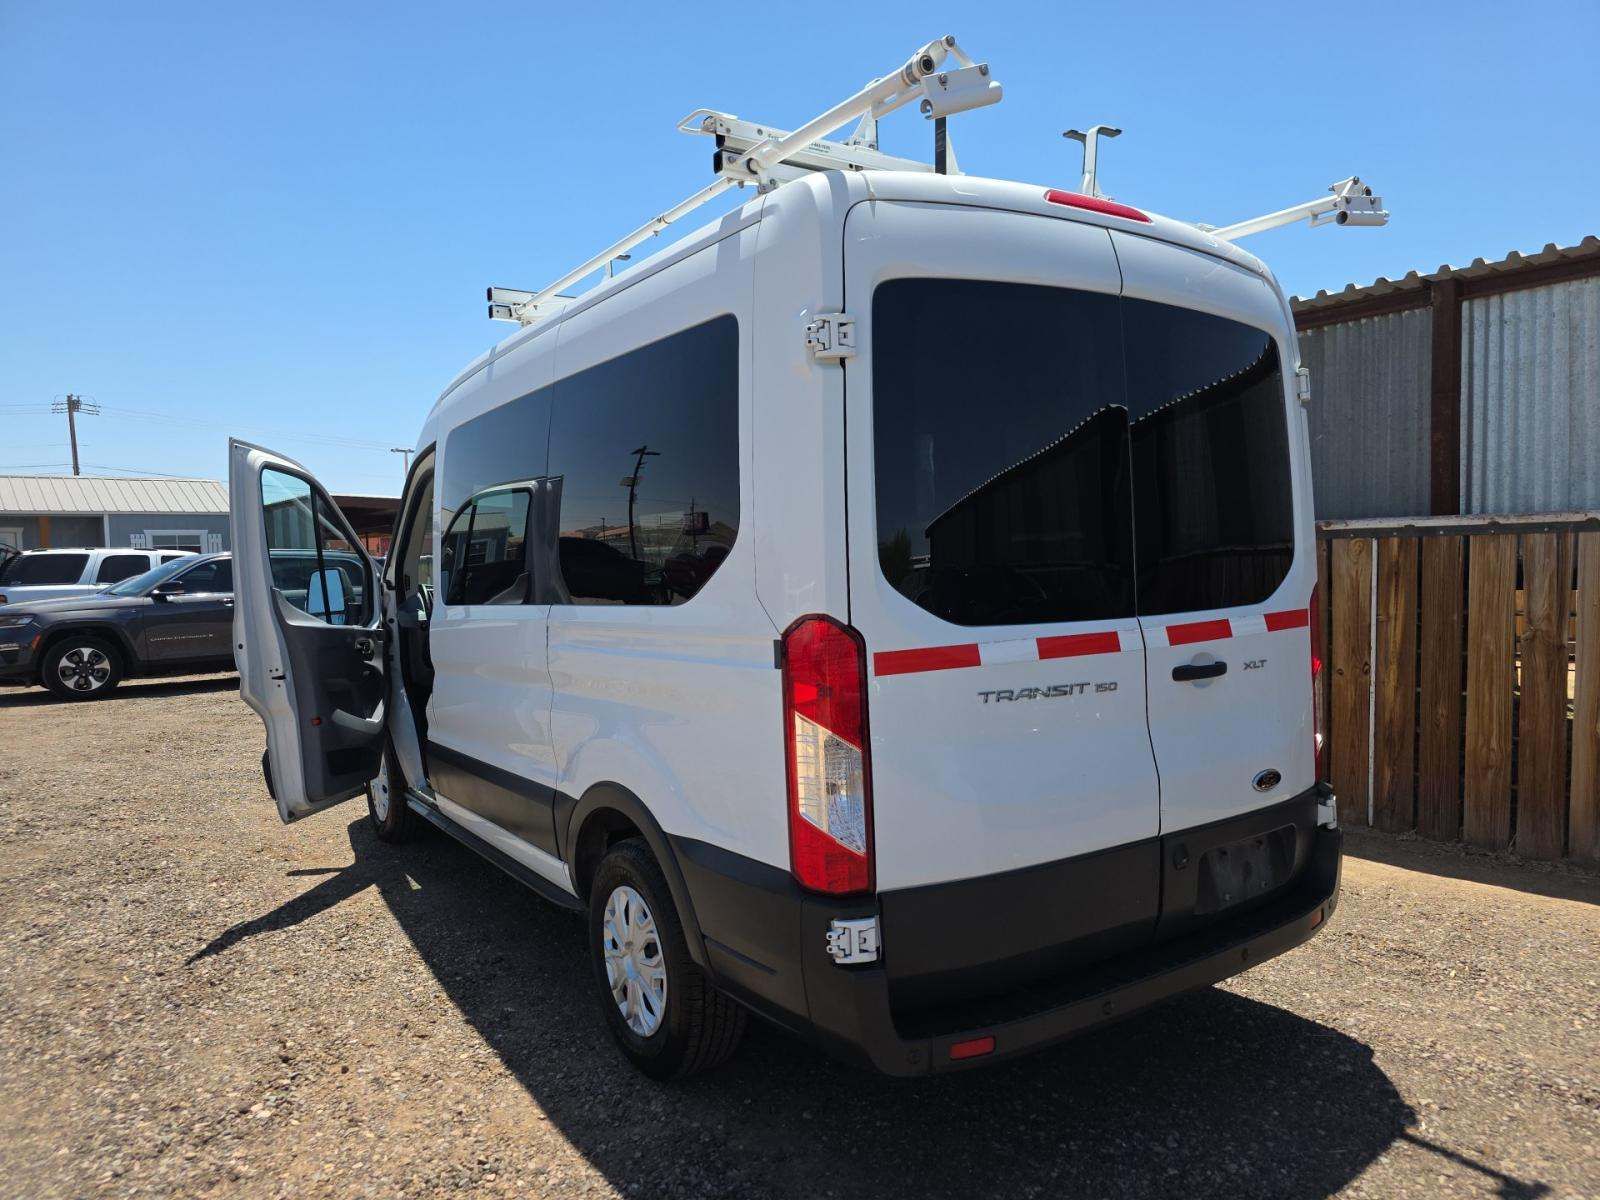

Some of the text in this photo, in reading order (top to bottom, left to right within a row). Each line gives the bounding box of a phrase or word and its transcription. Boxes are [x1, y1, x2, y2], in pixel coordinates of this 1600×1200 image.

[1243, 659, 1267, 670] XLT
[978, 681, 1118, 704] TRANSIT 150
